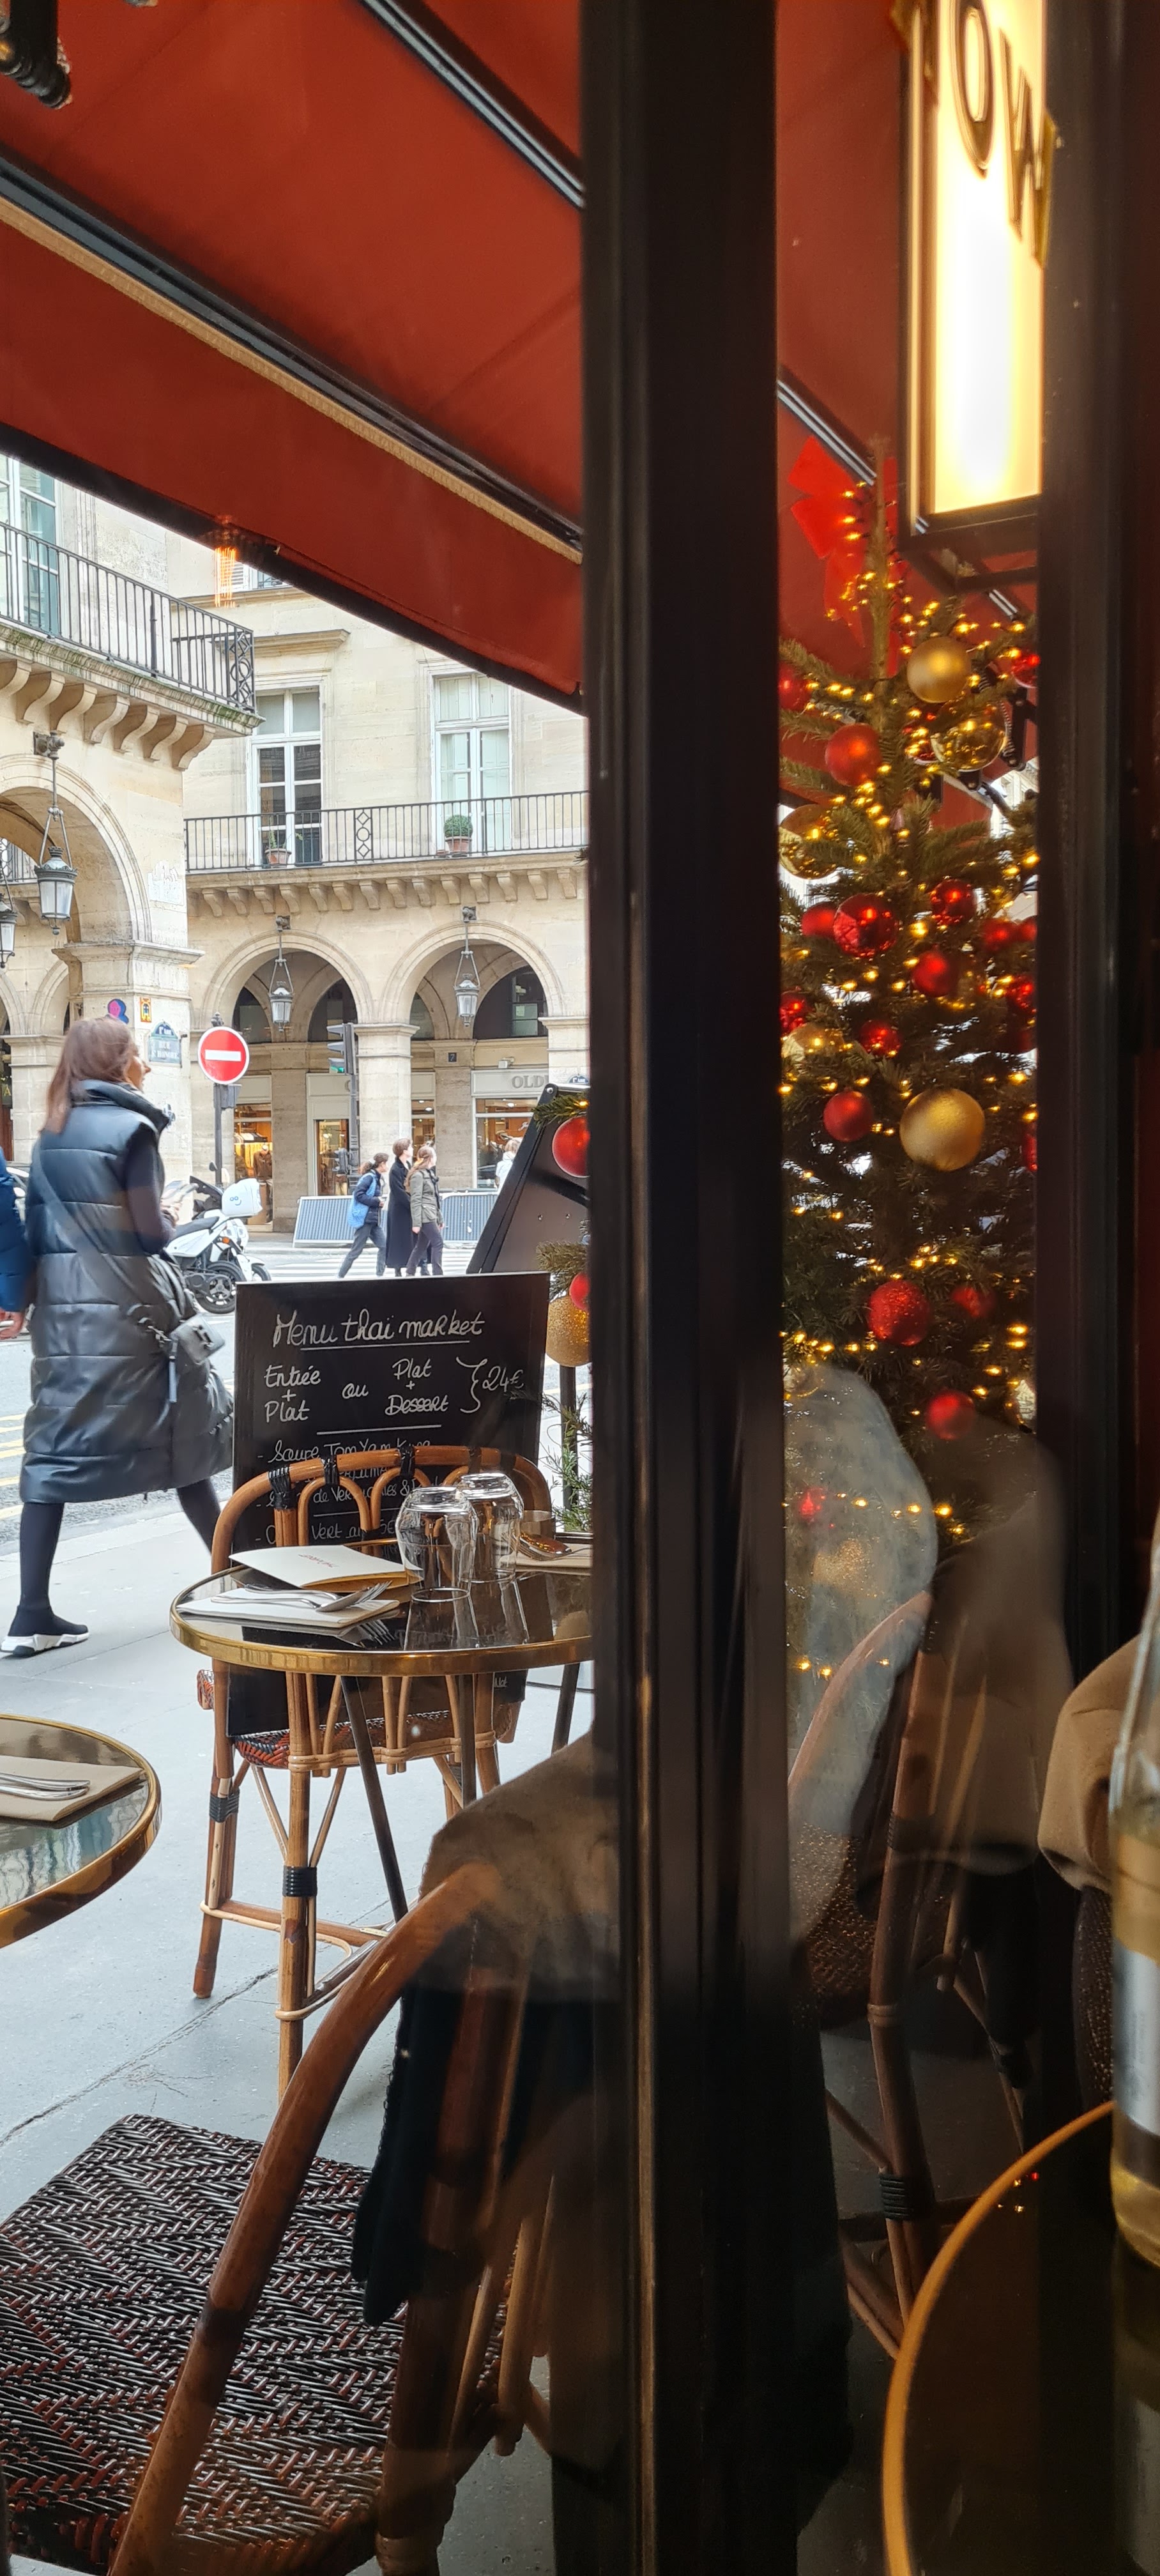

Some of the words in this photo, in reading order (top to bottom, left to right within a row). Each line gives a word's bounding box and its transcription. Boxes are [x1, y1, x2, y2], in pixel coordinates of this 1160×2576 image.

[273, 1310, 339, 1348] Menu
[341, 1308, 395, 1341] thaï
[399, 1309, 485, 1339] market
[264, 1365, 321, 1388] Entrée
[392, 1358, 432, 1380] Plat
[482, 1365, 524, 1392] 24€
[342, 1383, 369, 1399] ou
[264, 1400, 310, 1423] Plat
[385, 1394, 449, 1416] Dessert
[313, 1489, 329, 1503] de
[312, 1522, 342, 1540] Vert
